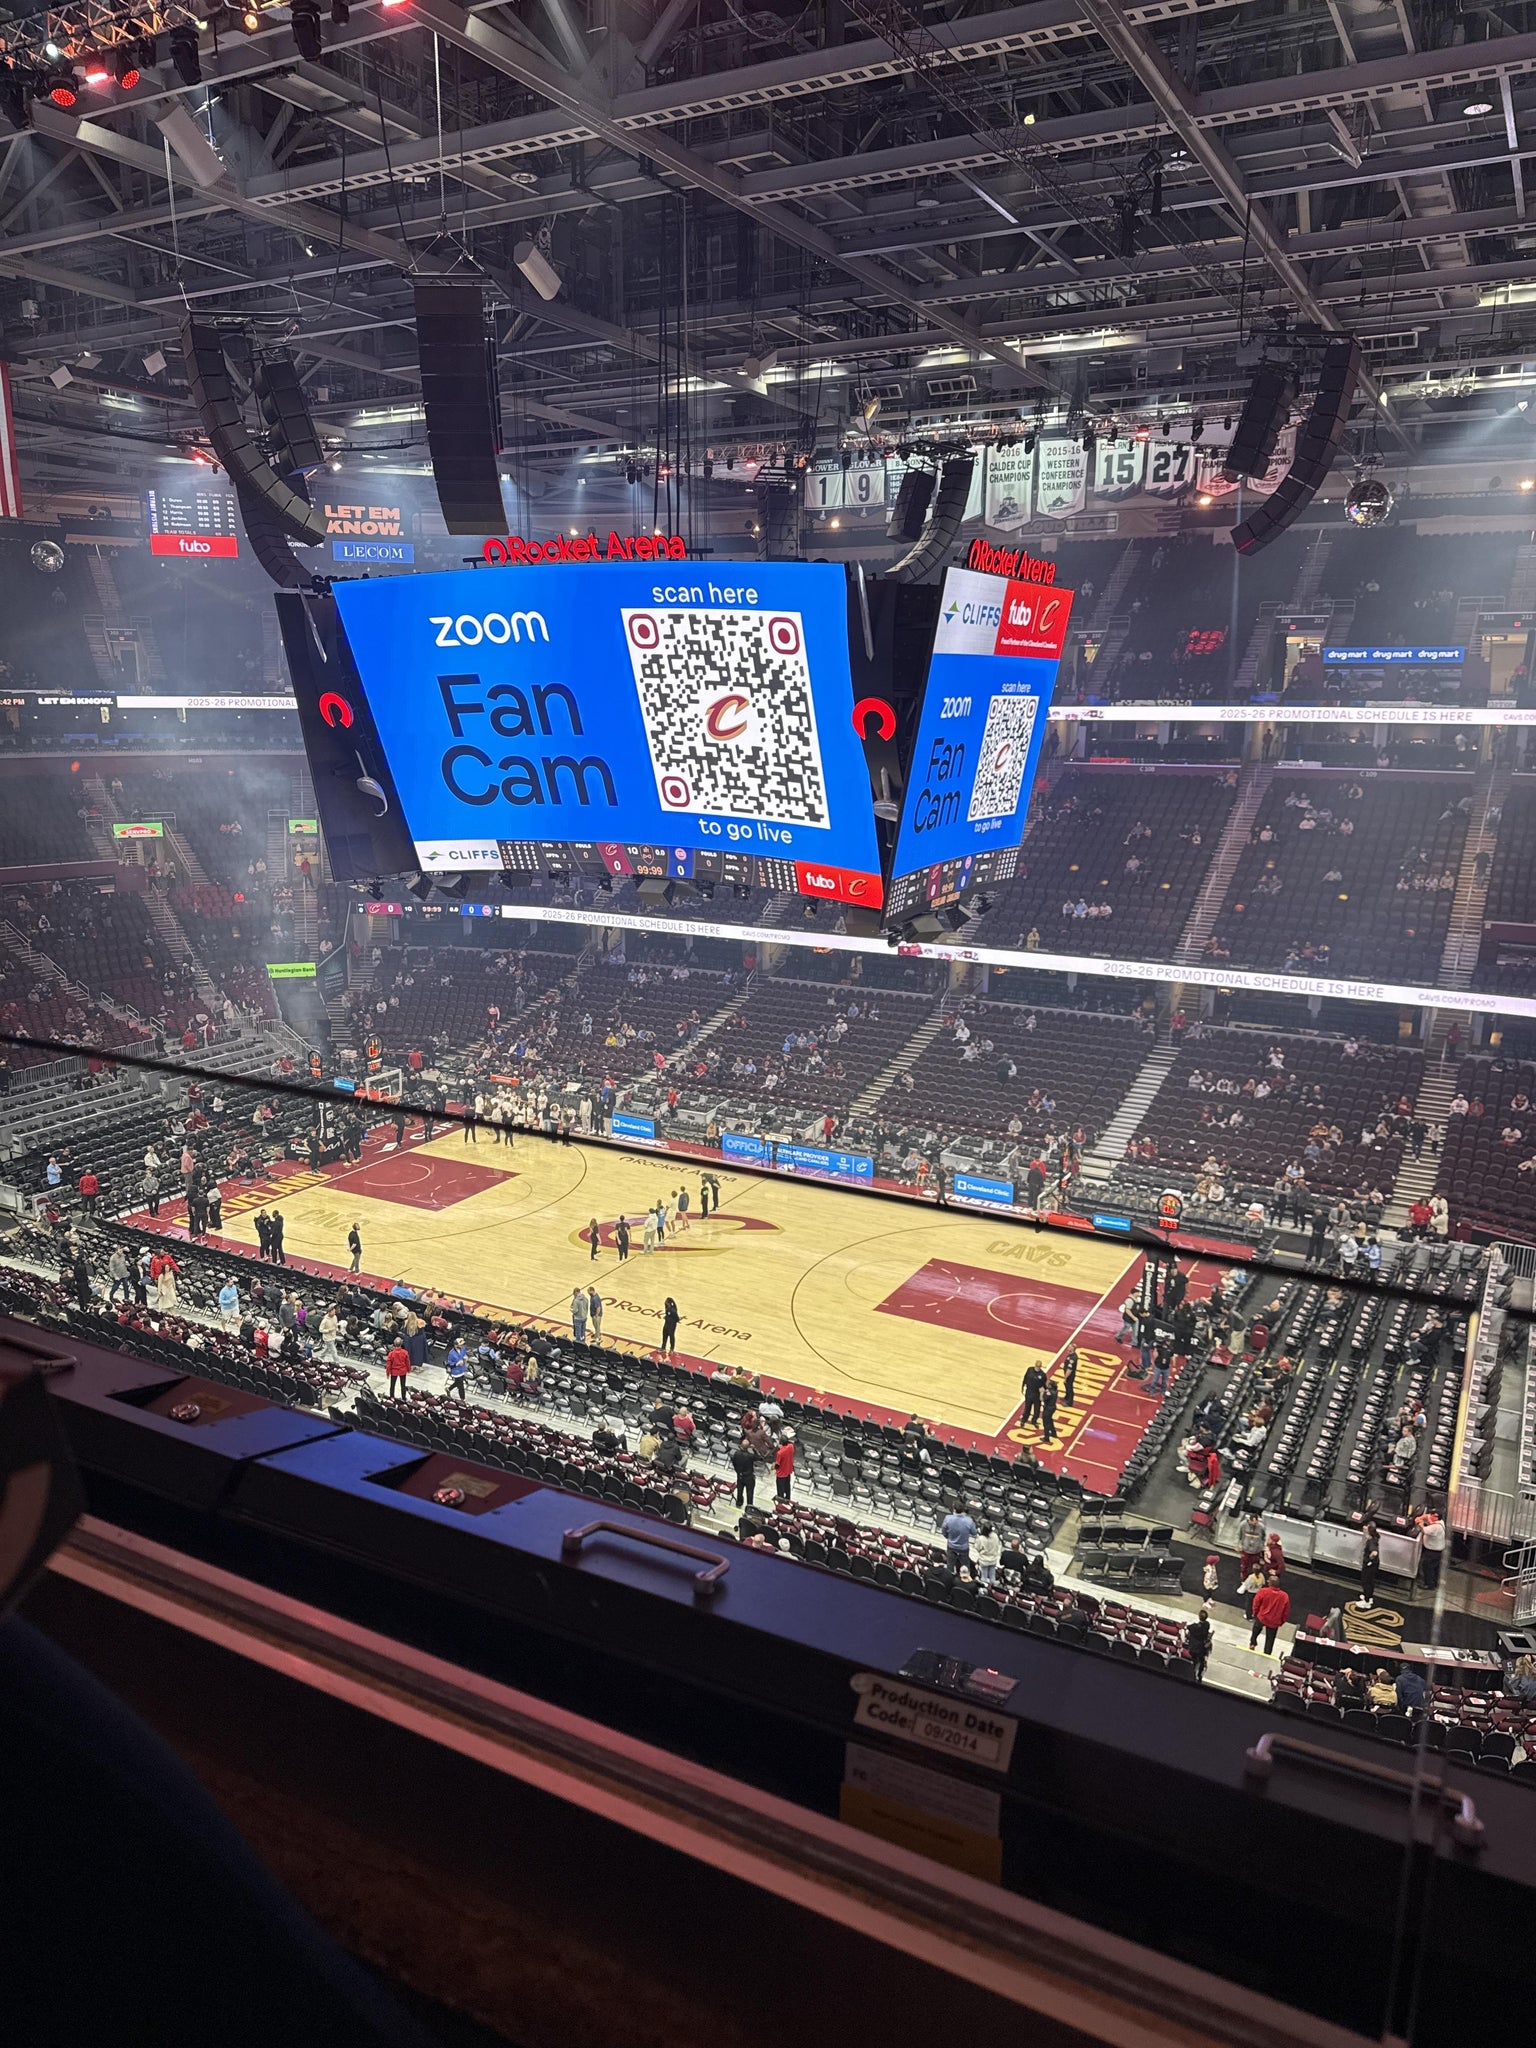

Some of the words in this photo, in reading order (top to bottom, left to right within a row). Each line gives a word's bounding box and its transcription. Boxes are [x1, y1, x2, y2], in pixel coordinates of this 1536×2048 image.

[990, 461, 1015, 472] CALDER
[1017, 460, 1031, 470] CUP
[1041, 469, 1085, 480] CONFERENCE
[1047, 459, 1080, 469] WESTERN
[1103, 453, 1135, 485] 15
[1152, 450, 1189, 482] 27
[857, 473, 871, 503] 9
[990, 472, 1031, 483] CHAMPIONS
[1042, 481, 1081, 491] CHAMPIONS
[818, 475, 828, 506] 1
[324, 504, 366, 518] LET
[369, 506, 401, 520] EM
[326, 520, 405, 536] KNOW.
[179, 539, 211, 552] fubo
[506, 532, 601, 564] Rocket
[607, 531, 687, 560] Arena
[977, 540, 1020, 578] Rocket
[1017, 550, 1056, 584] Arena
[652, 586, 704, 603] scan
[708, 582, 759, 605] here
[962, 603, 1001, 628] CLIFFS
[1008, 598, 1032, 627] fubo
[429, 610, 550, 647] zoom
[187, 698, 226, 708] 2025-26
[228, 698, 297, 708] PROMOTIONAL
[437, 673, 585, 738] Fan
[940, 696, 972, 719] zoom
[1220, 709, 1266, 719] 2025-26
[1268, 709, 1352, 720] PROMOTIONAL
[1355, 710, 1419, 721] SCHEDULE
[1421, 711, 1437, 721] IS
[1439, 711, 1473, 722] HERE
[926, 737, 966, 784] Fan
[441, 744, 619, 807] Cam
[913, 788, 961, 834] Cam
[698, 818, 722, 836] to
[726, 823, 752, 841] go
[757, 822, 793, 844] live
[448, 850, 500, 860] CLIFFS
[613, 860, 621, 871] 0
[676, 865, 685, 876] 0
[805, 872, 836, 890] fubo
[542, 909, 576, 921] 2025-26
[577, 913, 638, 928] PROMOTIONAL
[639, 919, 684, 932] SCHEDULE
[686, 923, 696, 933] IS
[698, 925, 721, 935] HERE
[1103, 962, 1154, 977] 2025-26
[1156, 968, 1251, 986] PROMOTIONAL
[1253, 976, 1327, 993] SCHEDULE
[1327, 982, 1344, 994] IS
[1348, 984, 1385, 998] HERE
[633, 1158, 688, 1173] Rocket
[966, 1183, 994, 1194] Cleveland
[994, 1187, 1010, 1197] Clinic
[986, 1241, 1072, 1267] CAVS
[614, 1300, 688, 1324] Rockt
[686, 1319, 753, 1341] Arena
[871, 1683, 959, 1723] Production
[963, 1712, 1005, 1739] Date
[866, 1703, 913, 1732] Code:
[922, 1721, 979, 1751] 09/2014
